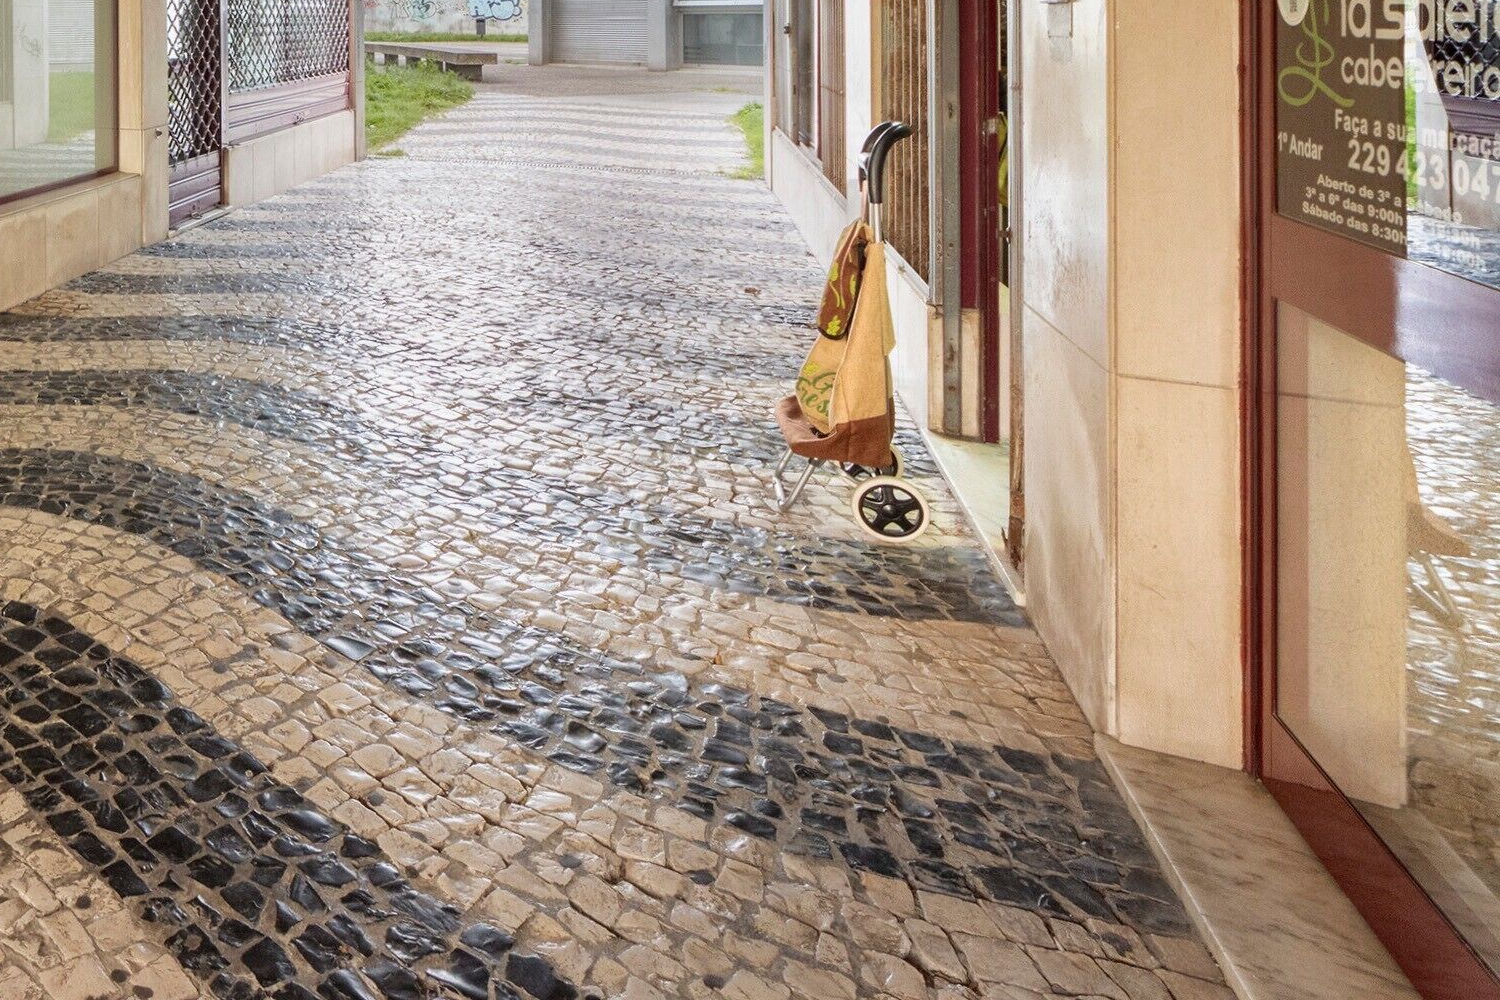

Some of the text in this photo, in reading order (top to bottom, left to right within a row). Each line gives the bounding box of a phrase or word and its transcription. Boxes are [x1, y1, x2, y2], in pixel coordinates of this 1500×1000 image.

[1334, 108, 1368, 138] Faça
[1373, 120, 1382, 138] a
[1289, 133, 1323, 161] Andar
[1347, 138, 1391, 177] 229
[1395, 149, 1445, 190] 423
[1317, 173, 1356, 195] Aberto
[1359, 185, 1374, 200] de
[1377, 189, 1391, 203] 3ª
[1394, 196, 1402, 208] a
[1302, 201, 1344, 225] Sábado
[1346, 216, 1369, 233] das
[1371, 222, 1408, 246] 8:30h
[1318, 193, 1326, 203] a
[1342, 197, 1365, 215] das
[1367, 203, 1404, 227] 9:00h
